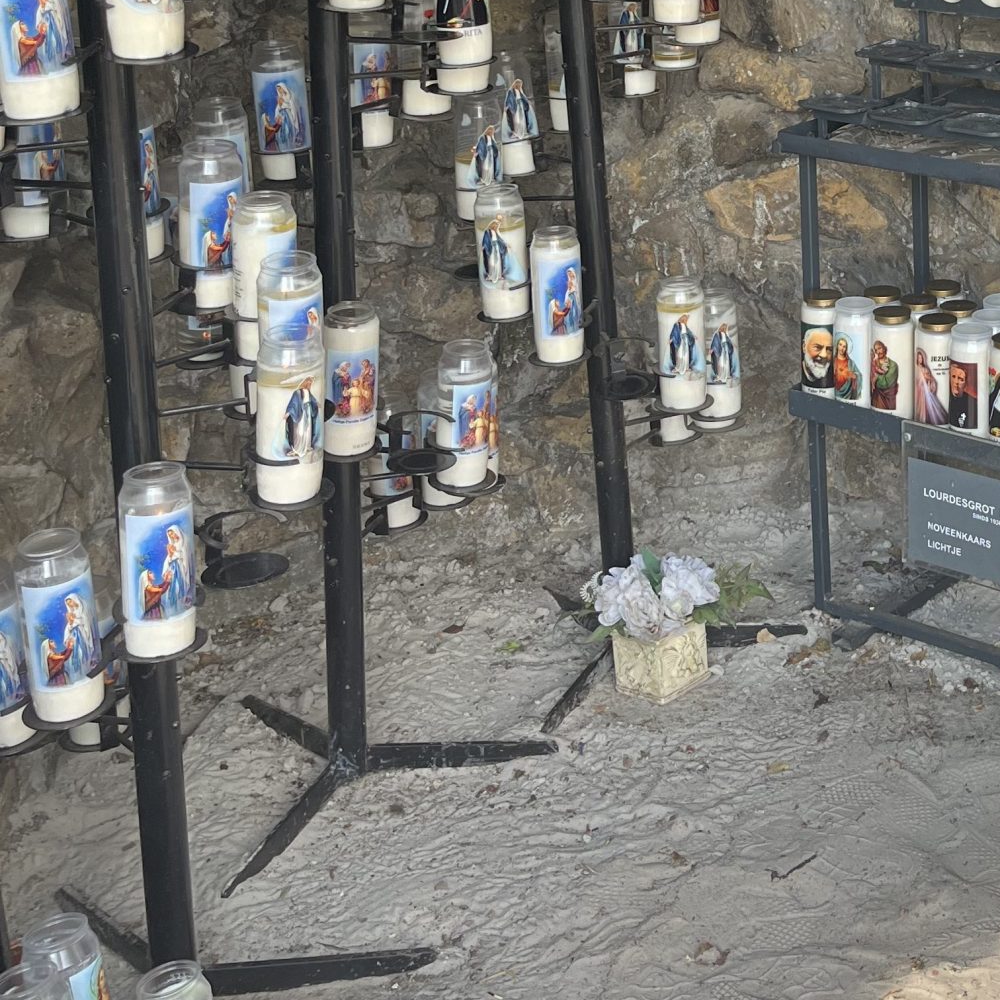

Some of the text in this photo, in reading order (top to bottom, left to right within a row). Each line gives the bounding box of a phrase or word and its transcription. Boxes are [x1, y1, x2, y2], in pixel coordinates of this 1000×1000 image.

[923, 488, 995, 515] LOURDESGROT
[927, 521, 992, 549] NOVEENKAARS
[927, 540, 962, 557] LICHTJE
